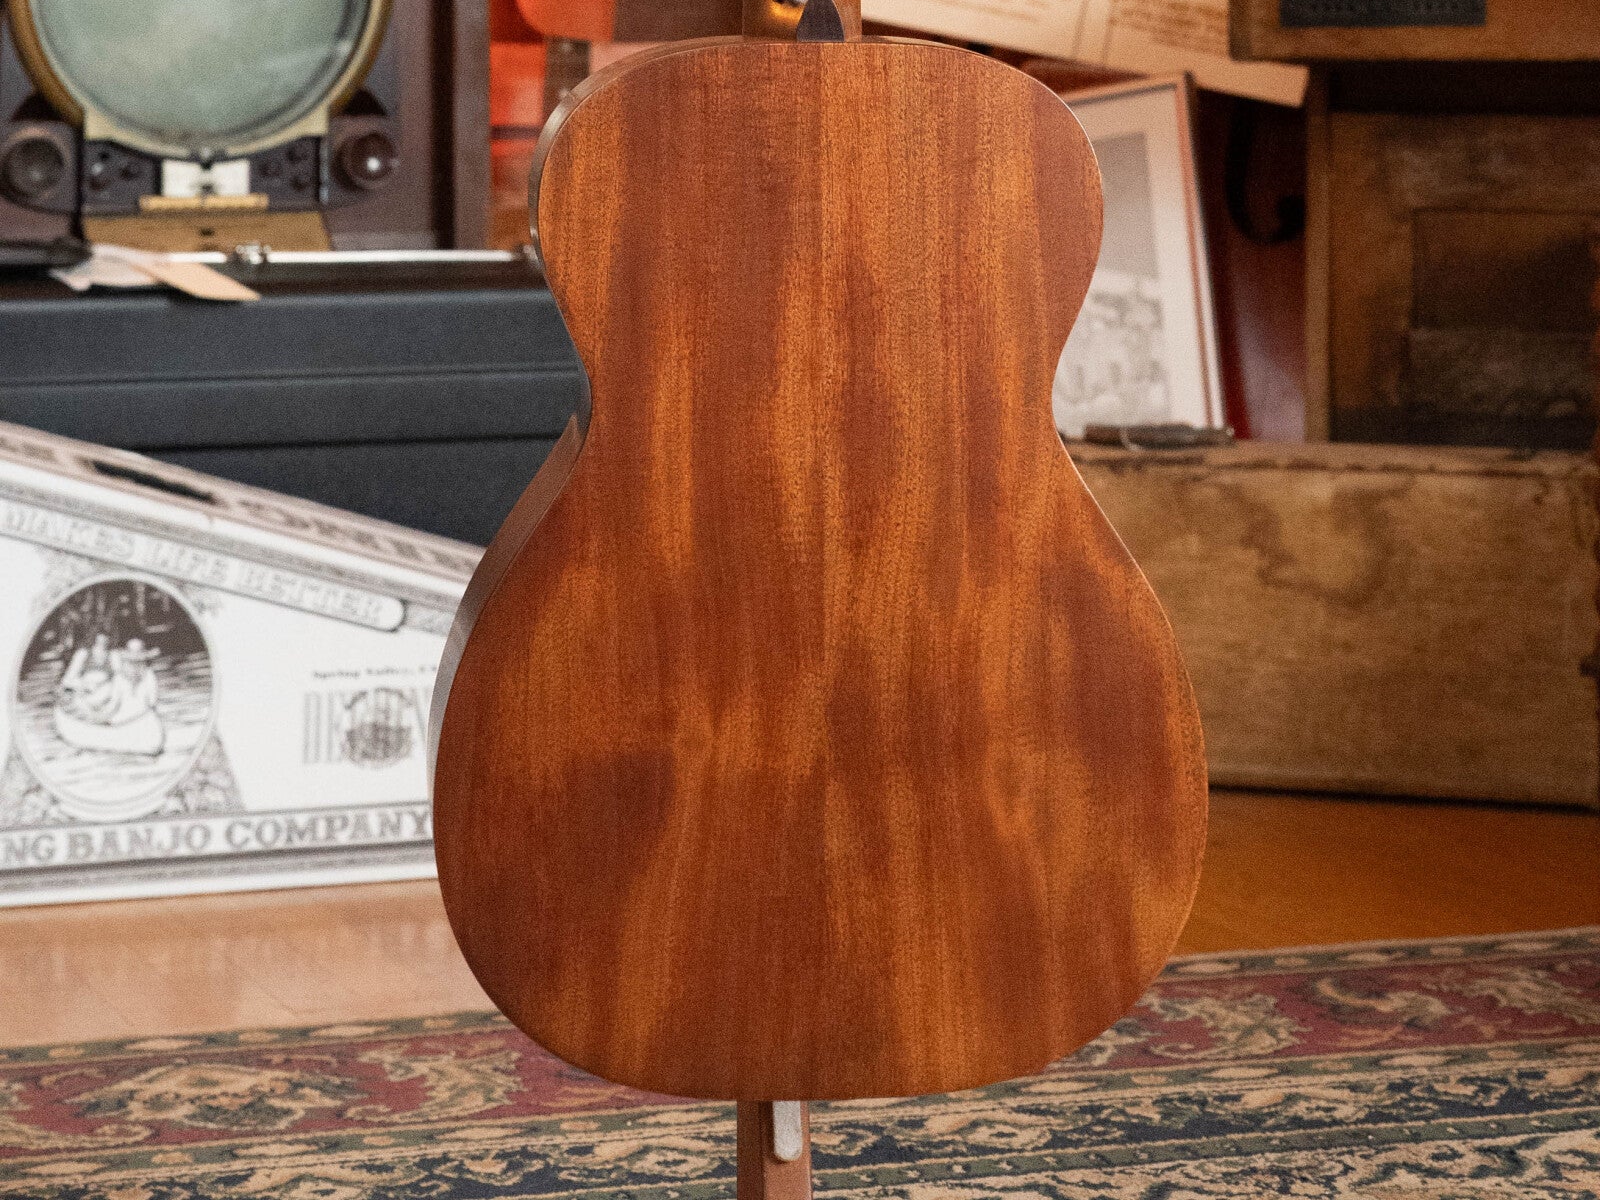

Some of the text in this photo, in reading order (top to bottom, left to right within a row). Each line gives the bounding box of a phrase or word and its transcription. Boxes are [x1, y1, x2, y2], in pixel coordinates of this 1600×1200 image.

[240, 562, 385, 623] BETTER
[67, 823, 211, 861] BANJO
[224, 809, 433, 848] COMPANY
